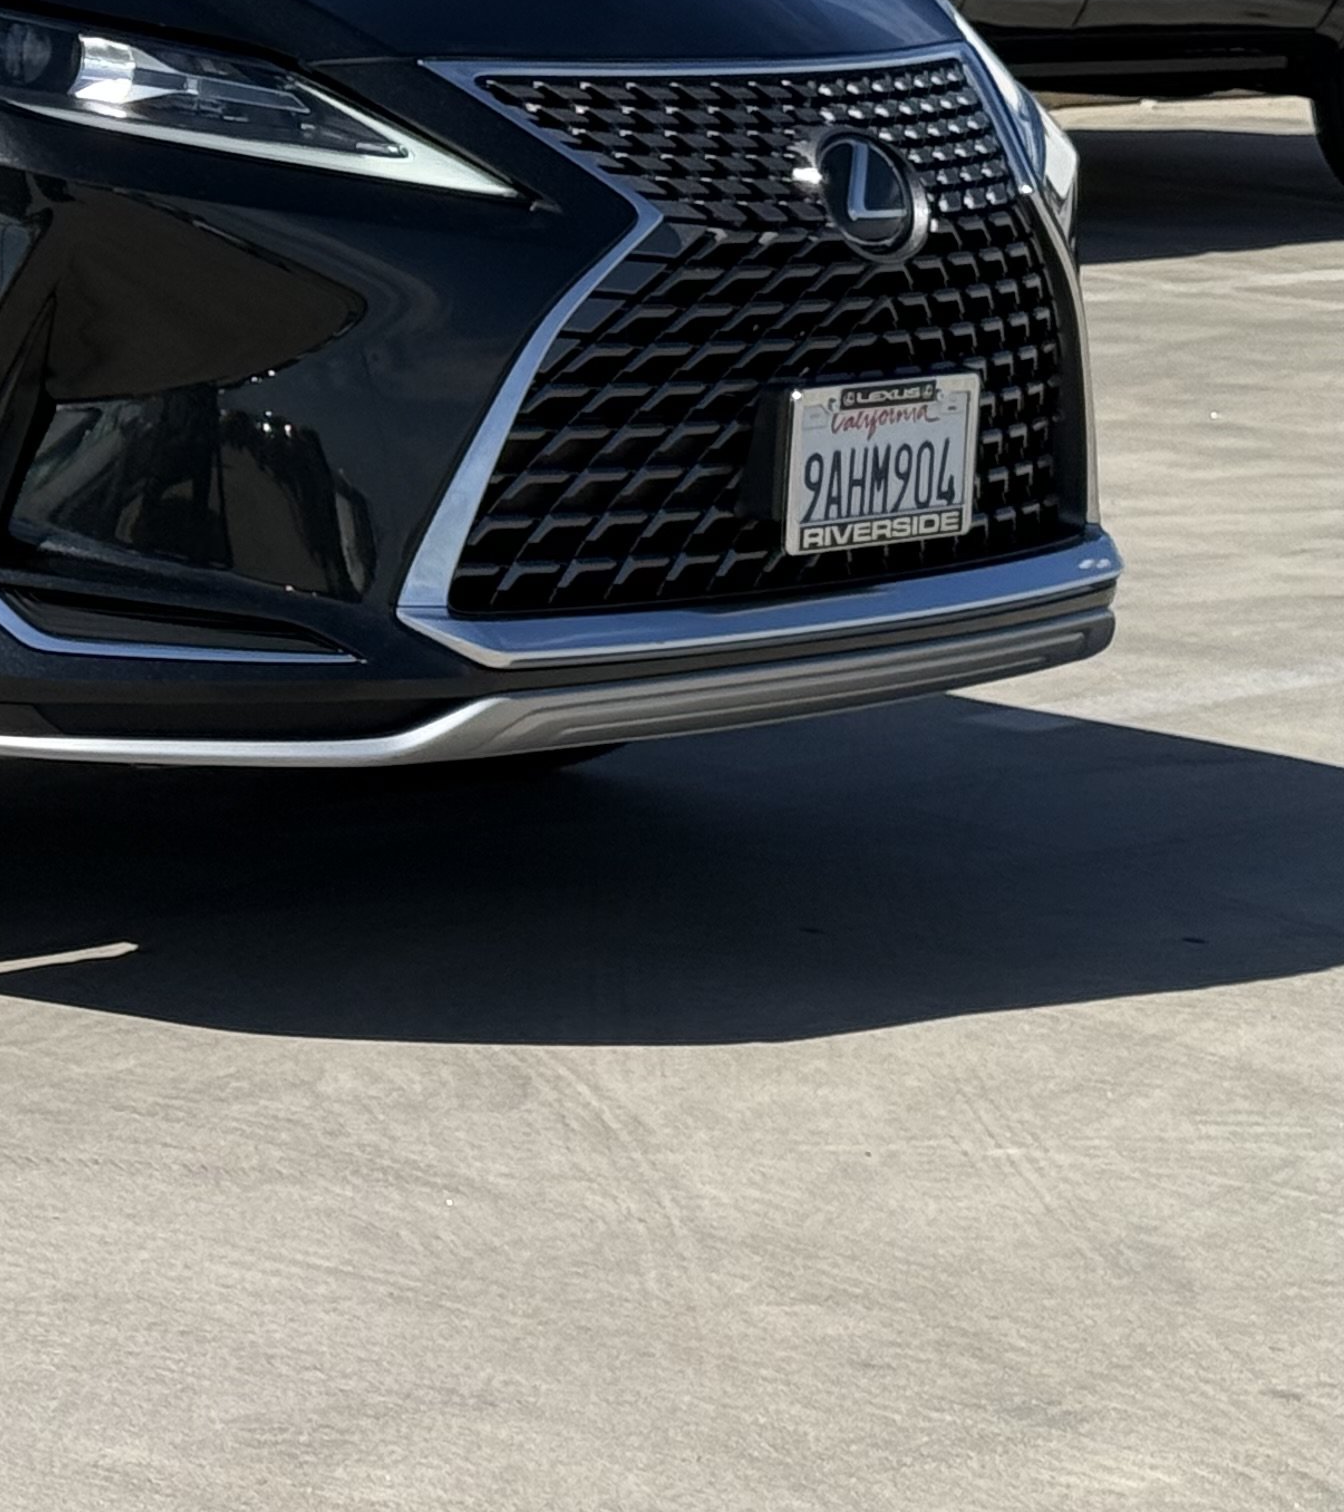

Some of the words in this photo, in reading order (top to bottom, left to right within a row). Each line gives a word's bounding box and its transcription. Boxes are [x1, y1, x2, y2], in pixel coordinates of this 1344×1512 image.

[856, 387, 921, 404] LEXUS
[831, 405, 939, 439] California
[802, 438, 955, 523] 9AHM904
[804, 512, 960, 548] RIVERSIDE
